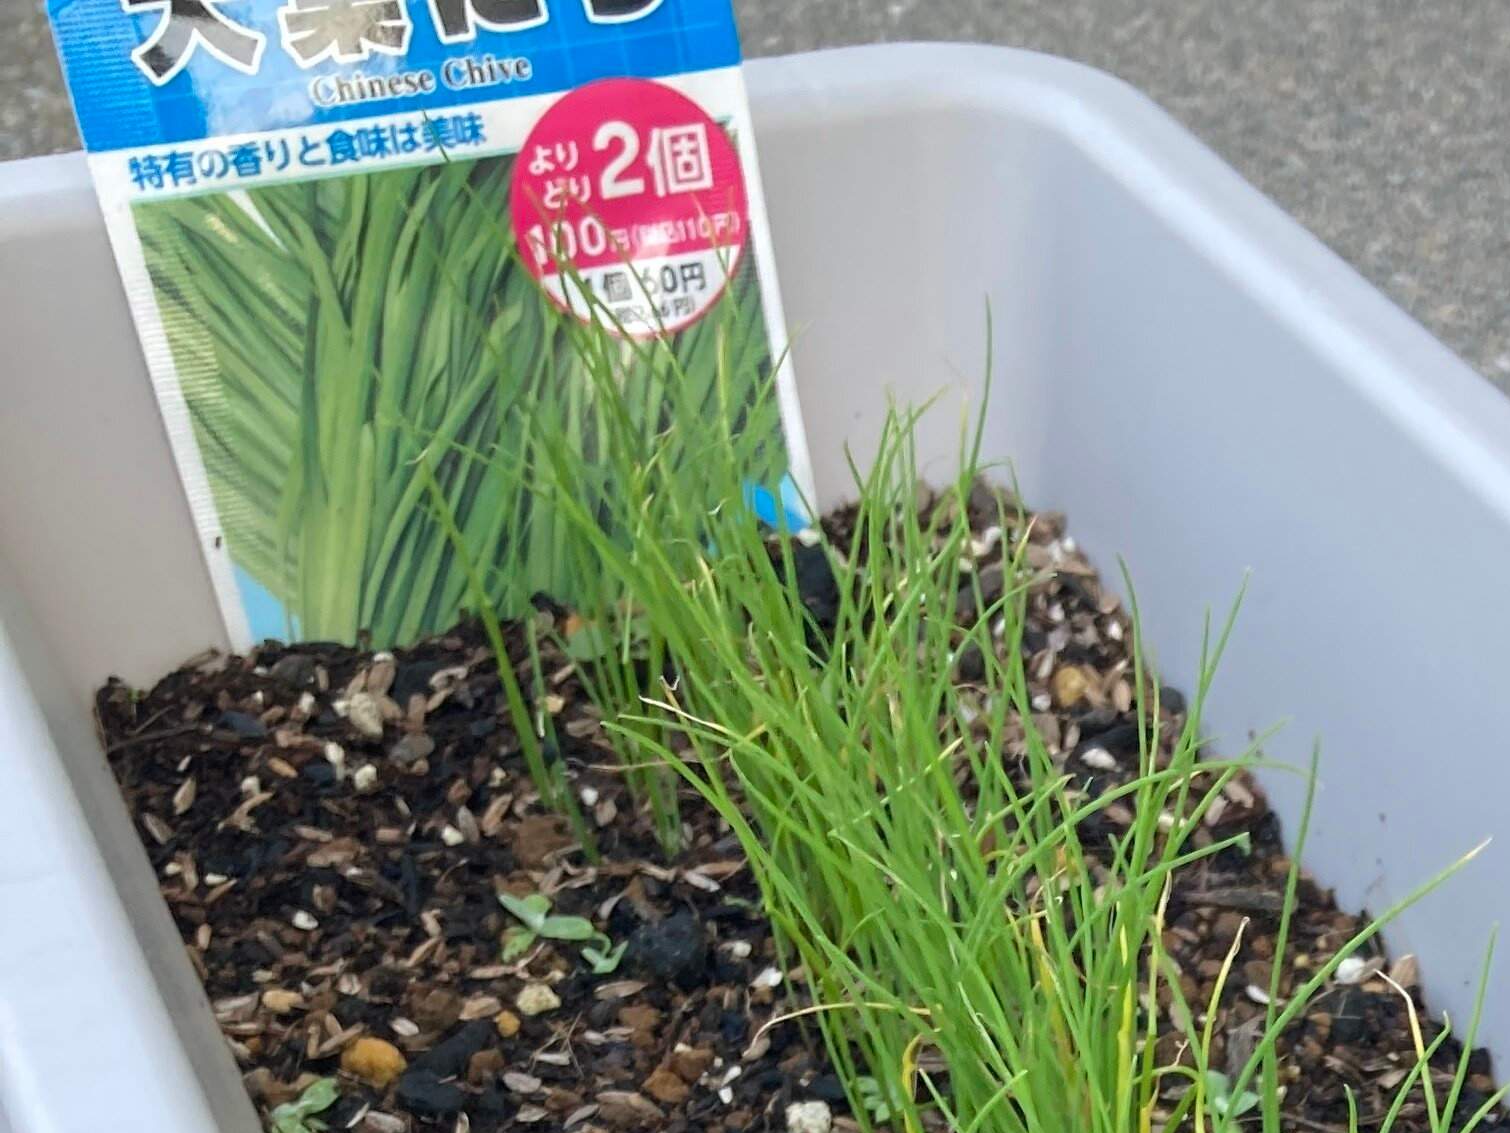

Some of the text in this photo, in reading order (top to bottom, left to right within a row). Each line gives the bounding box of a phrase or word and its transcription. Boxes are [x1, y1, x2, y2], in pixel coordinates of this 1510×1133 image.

[311, 55, 531, 105] Chinese Chive
[128, 112, 486, 190] 特有の香りと食味は美味
[528, 141, 578, 175] より
[592, 120, 713, 200] 2個
[543, 175, 592, 208] どり
